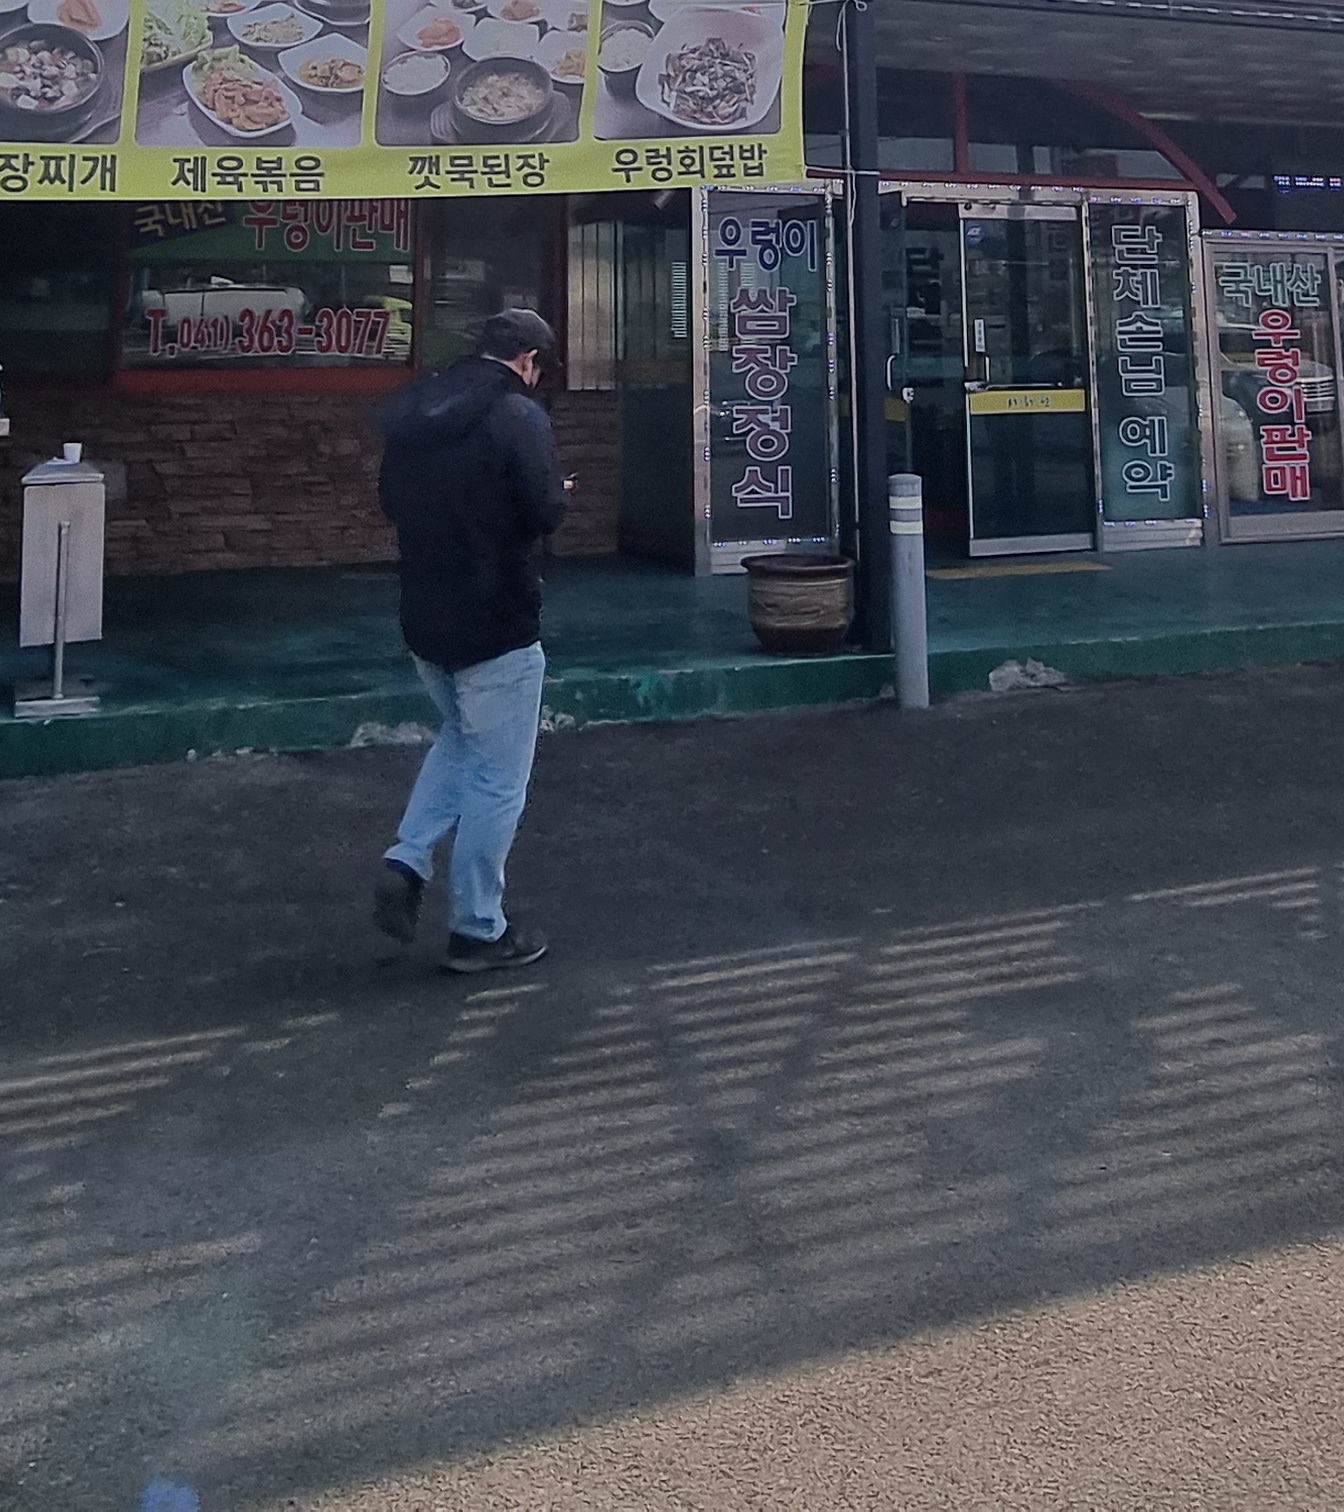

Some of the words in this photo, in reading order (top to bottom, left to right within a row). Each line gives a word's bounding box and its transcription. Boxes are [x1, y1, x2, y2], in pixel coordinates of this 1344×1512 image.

[170, 154, 326, 194] 제육볶음
[407, 152, 550, 190] 깻묵된장
[611, 143, 768, 184] 우렁회덮밥
[713, 217, 818, 272] 우렁이
[1218, 261, 1323, 308] 국내산
[1111, 224, 1164, 398] 단체손님
[729, 286, 798, 520] 쌈장정식
[1119, 416, 1175, 502] 예약
